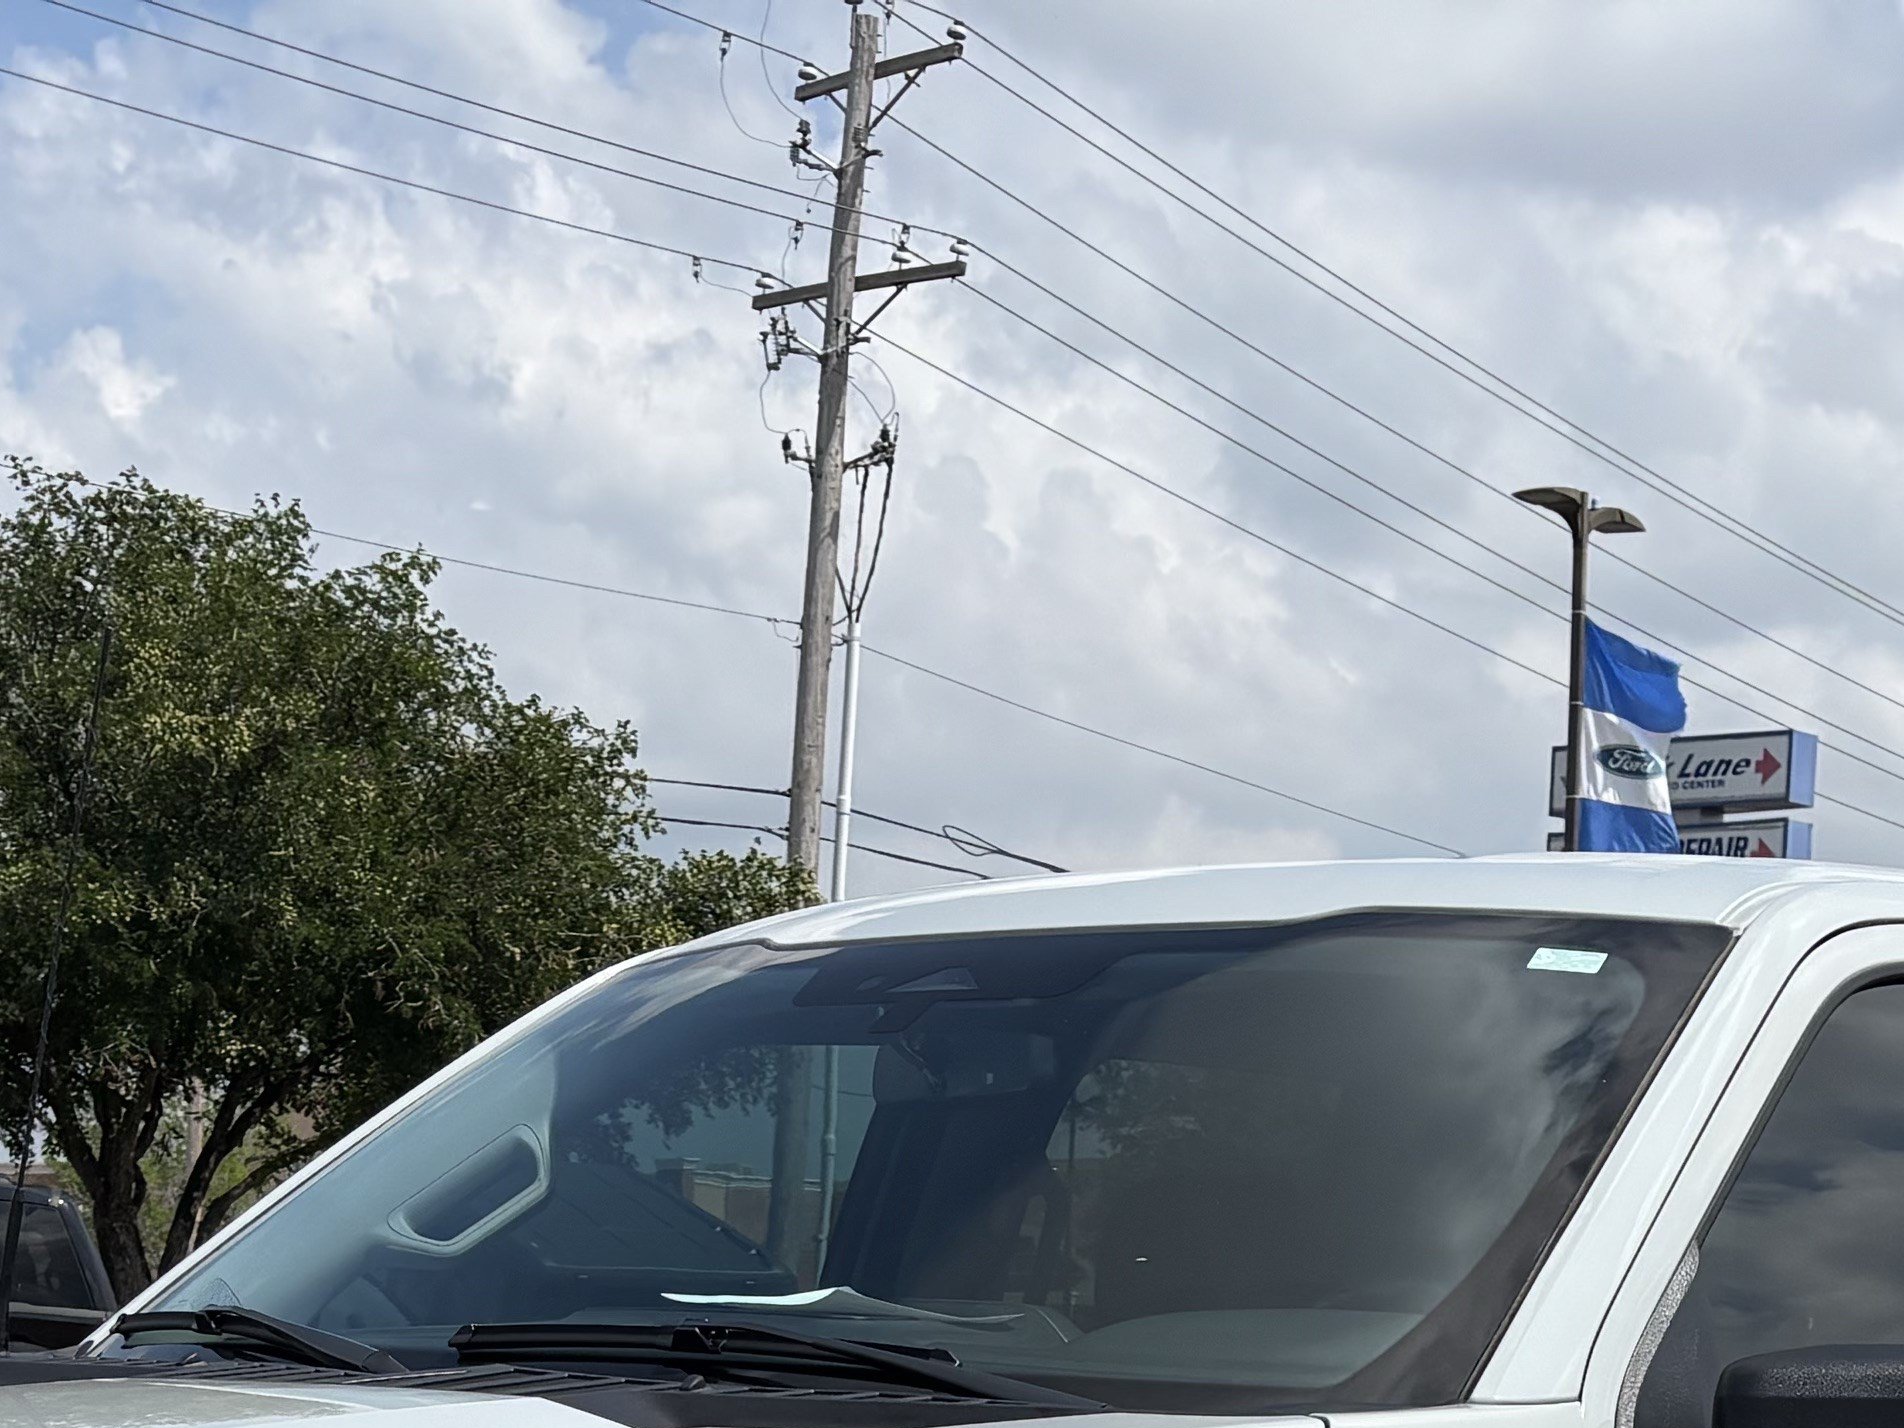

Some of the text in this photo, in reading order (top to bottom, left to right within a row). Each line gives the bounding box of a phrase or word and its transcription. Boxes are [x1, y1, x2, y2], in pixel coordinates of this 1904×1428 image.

[1608, 749, 1656, 775] Ford
[1677, 753, 1752, 779] Lane
[1682, 779, 1726, 790] CENTER
